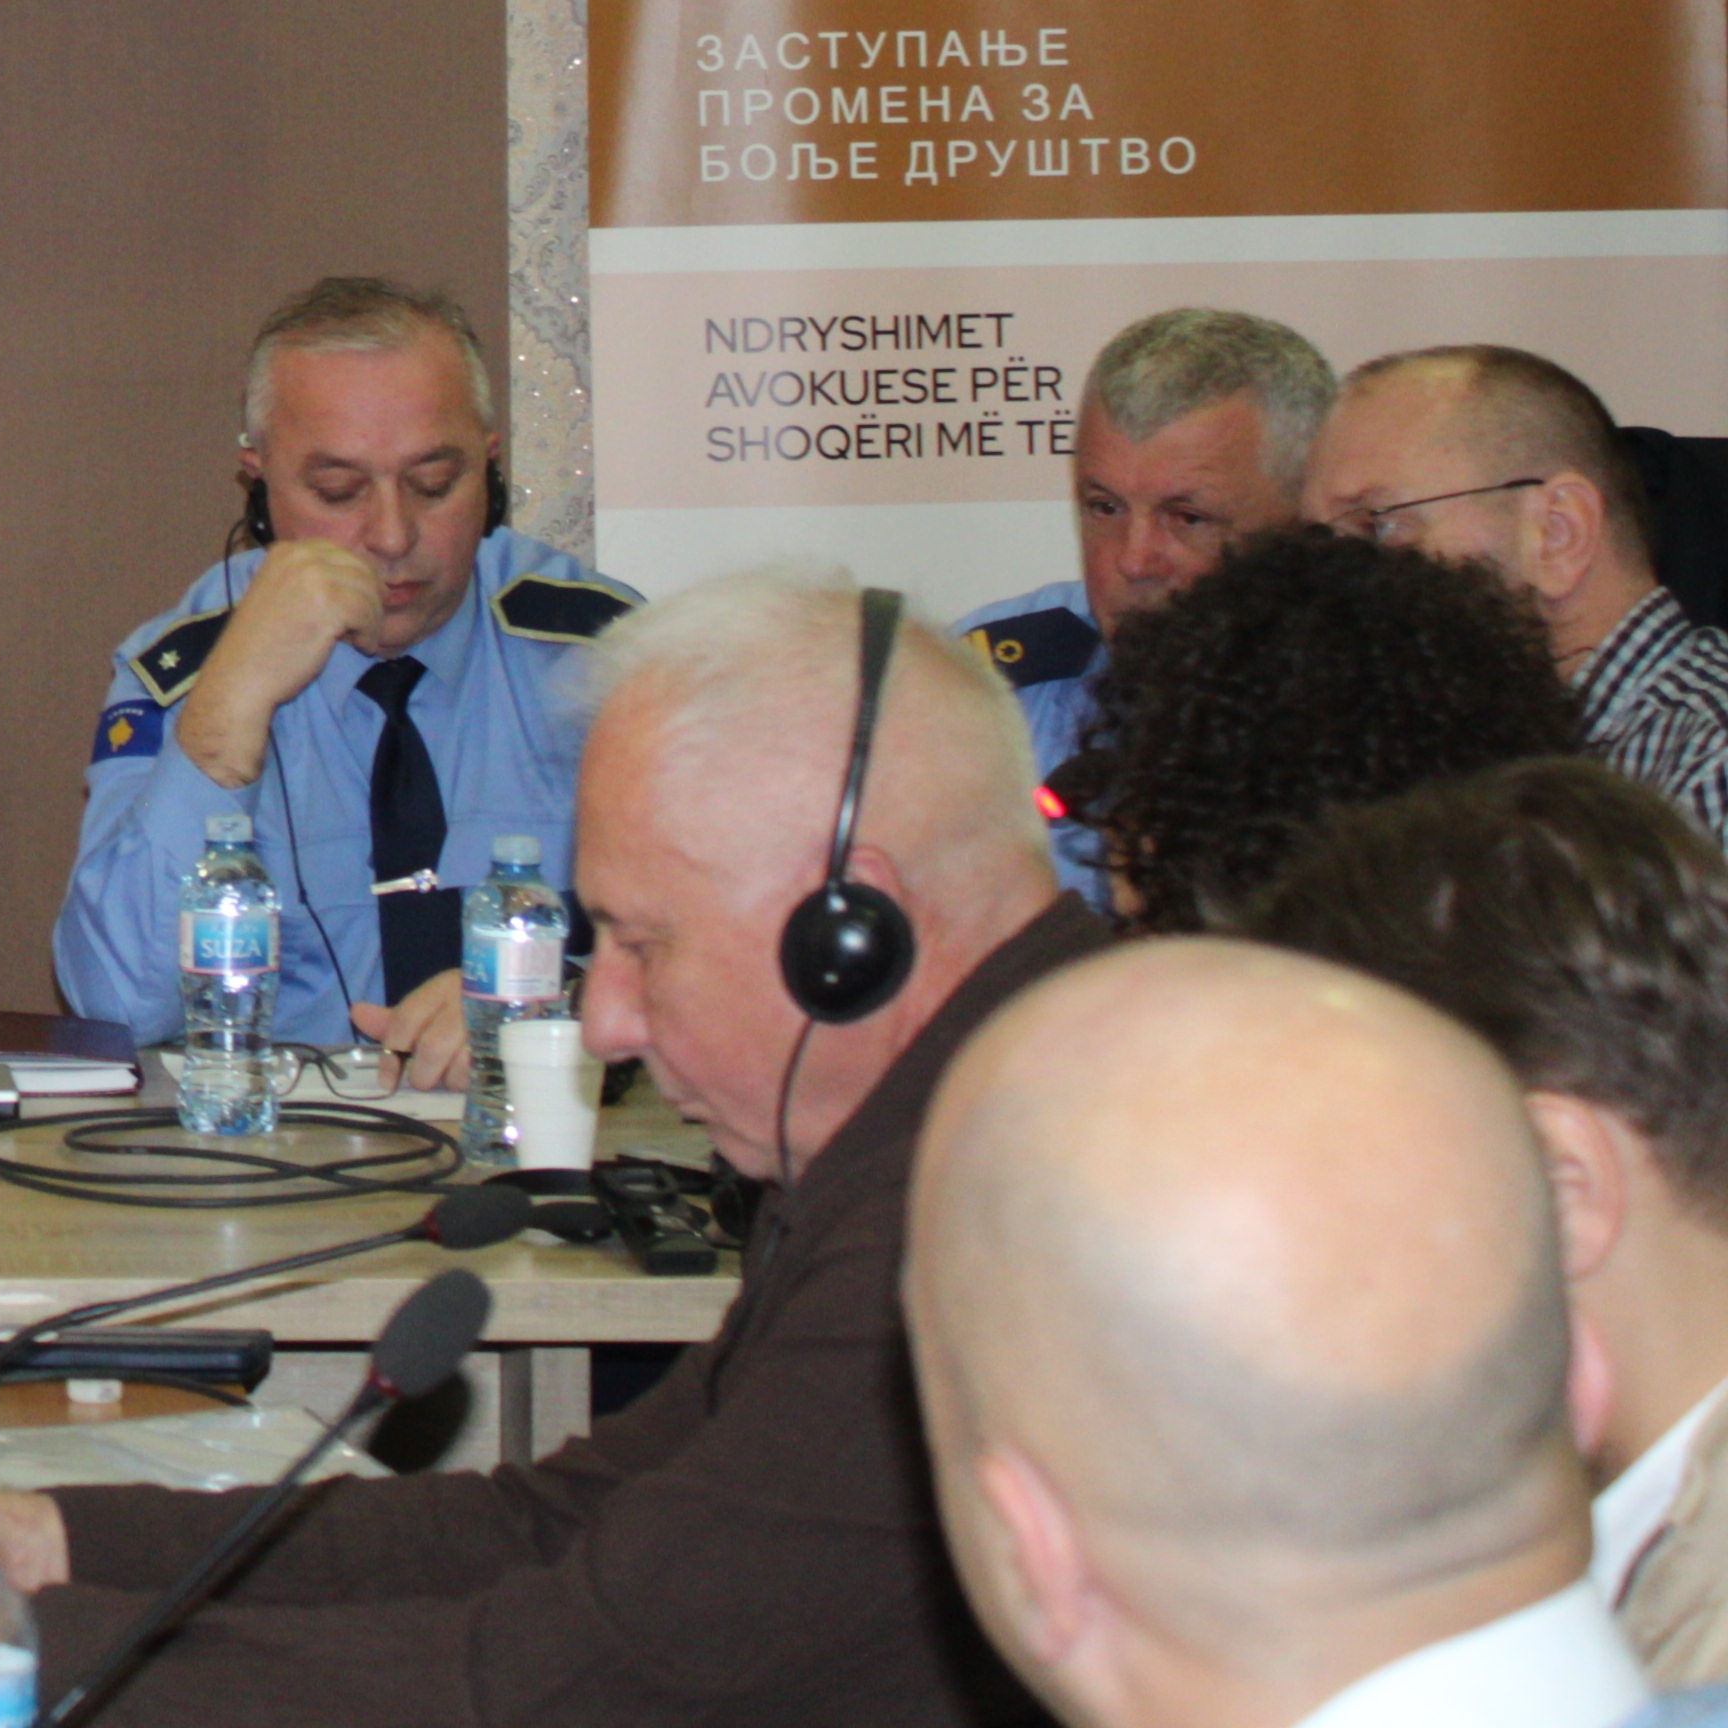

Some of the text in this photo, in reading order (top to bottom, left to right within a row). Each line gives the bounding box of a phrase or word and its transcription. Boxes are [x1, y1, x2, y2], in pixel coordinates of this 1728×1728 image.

[697, 29, 1070, 71] ЗАСТУПАЊЕ
[699, 83, 1094, 127] ПРОМЕНА ЗА
[700, 137, 1196, 186] БОЉЕ ДРУШТВО
[706, 313, 1013, 355] NDRYSHIMET
[706, 357, 1063, 409] AVOKUESE PËR
[706, 410, 1075, 462] SHOQËRI MË TË
[201, 939, 263, 958] SUZA
